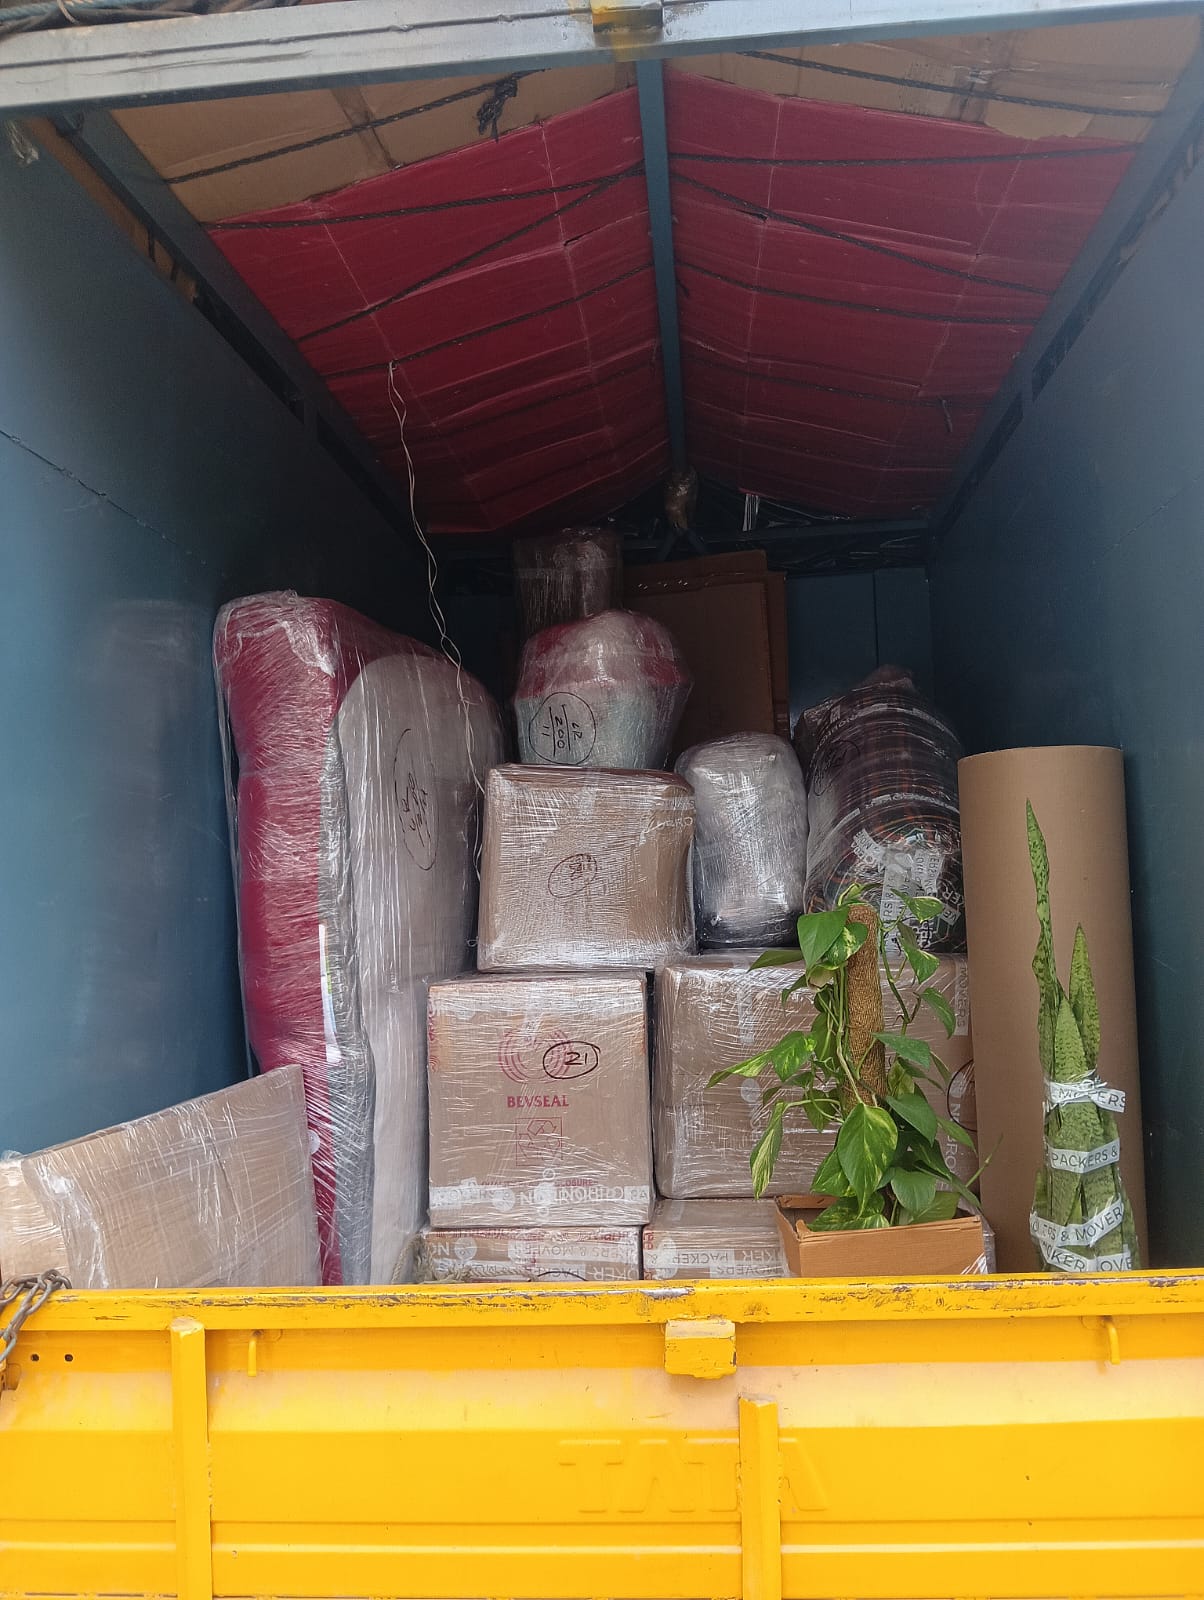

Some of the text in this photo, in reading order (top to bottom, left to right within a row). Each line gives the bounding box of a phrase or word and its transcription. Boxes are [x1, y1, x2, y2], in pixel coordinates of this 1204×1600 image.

[554, 715, 566, 750] 200
[565, 1051, 588, 1066] 21
[507, 1095, 569, 1108] BEVSEAL
[1052, 1147, 1118, 1168] PACKERS &
[1060, 1230, 1070, 1242] &
[558, 1437, 828, 1514] TATA
